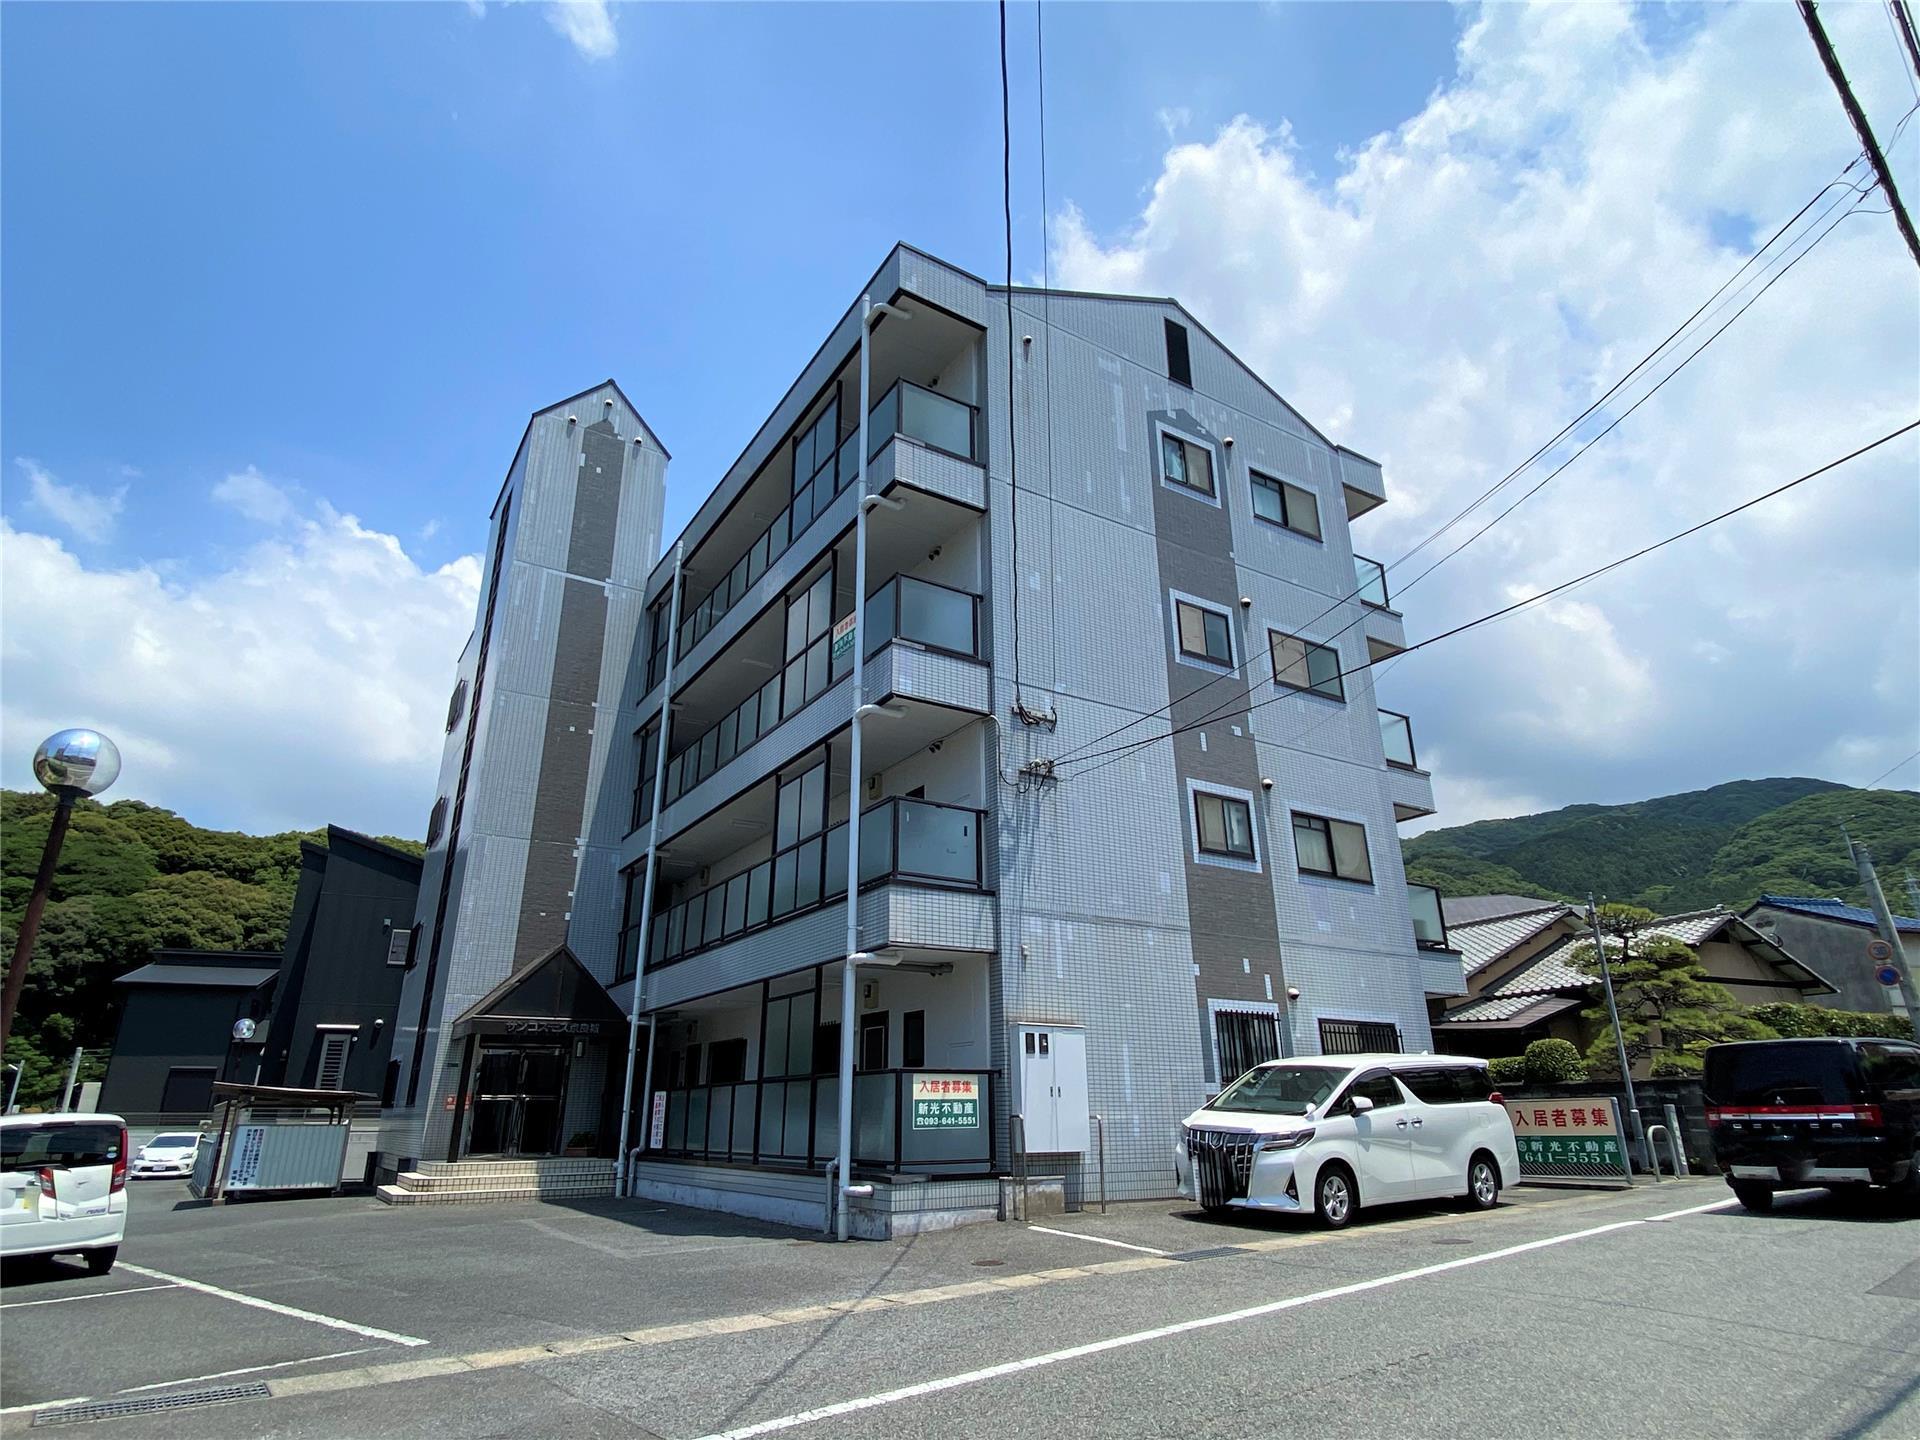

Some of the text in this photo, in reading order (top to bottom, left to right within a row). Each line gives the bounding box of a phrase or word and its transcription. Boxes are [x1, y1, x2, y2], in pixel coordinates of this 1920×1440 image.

[919, 1080, 972, 1093] 入居者募集
[918, 1102, 974, 1114] 新光不動産
[924, 1117, 976, 1125] 093-641-5551
[1515, 1107, 1609, 1127] 入居者募集
[1531, 1140, 1618, 1152] 新光不動産
